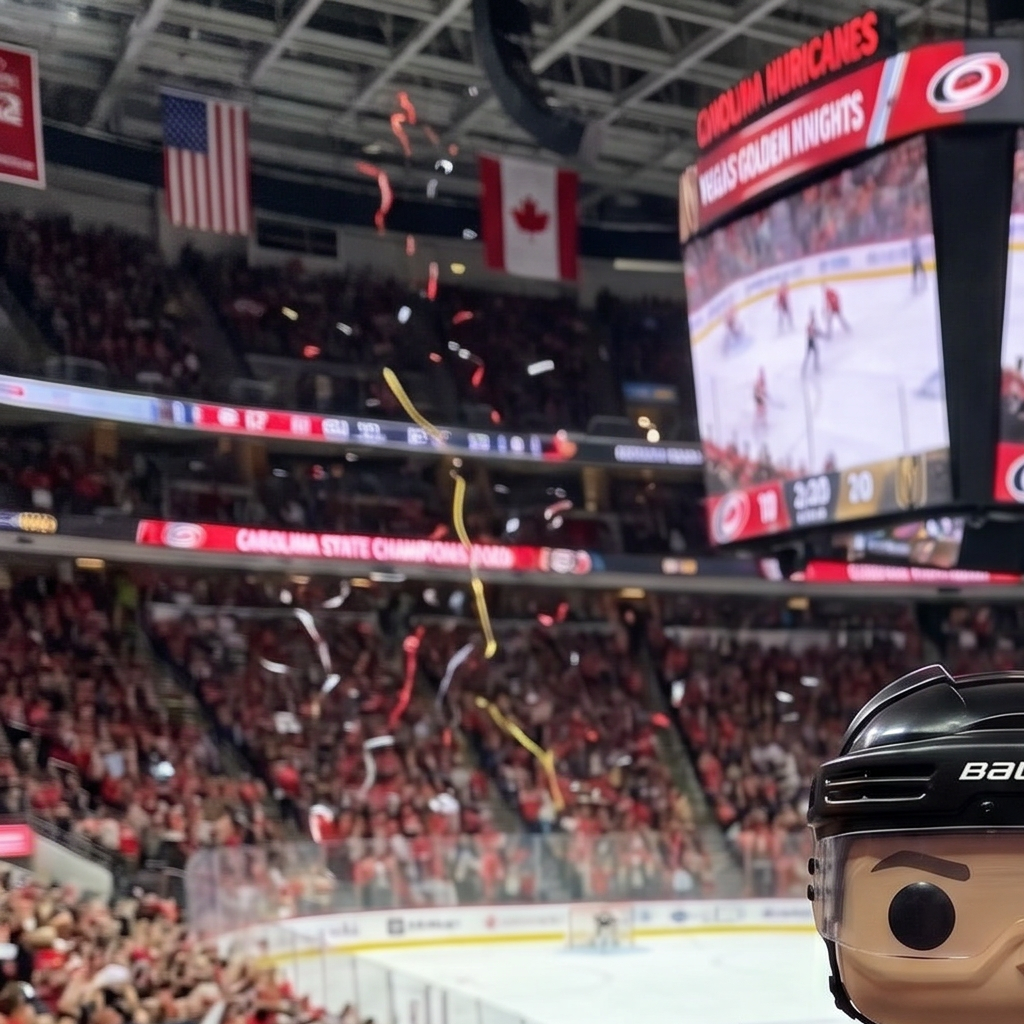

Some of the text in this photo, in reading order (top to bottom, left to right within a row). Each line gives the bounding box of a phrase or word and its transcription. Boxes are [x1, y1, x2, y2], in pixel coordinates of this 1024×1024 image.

[699, 89, 866, 207] VEGAS GOLDEN KNIGHTS
